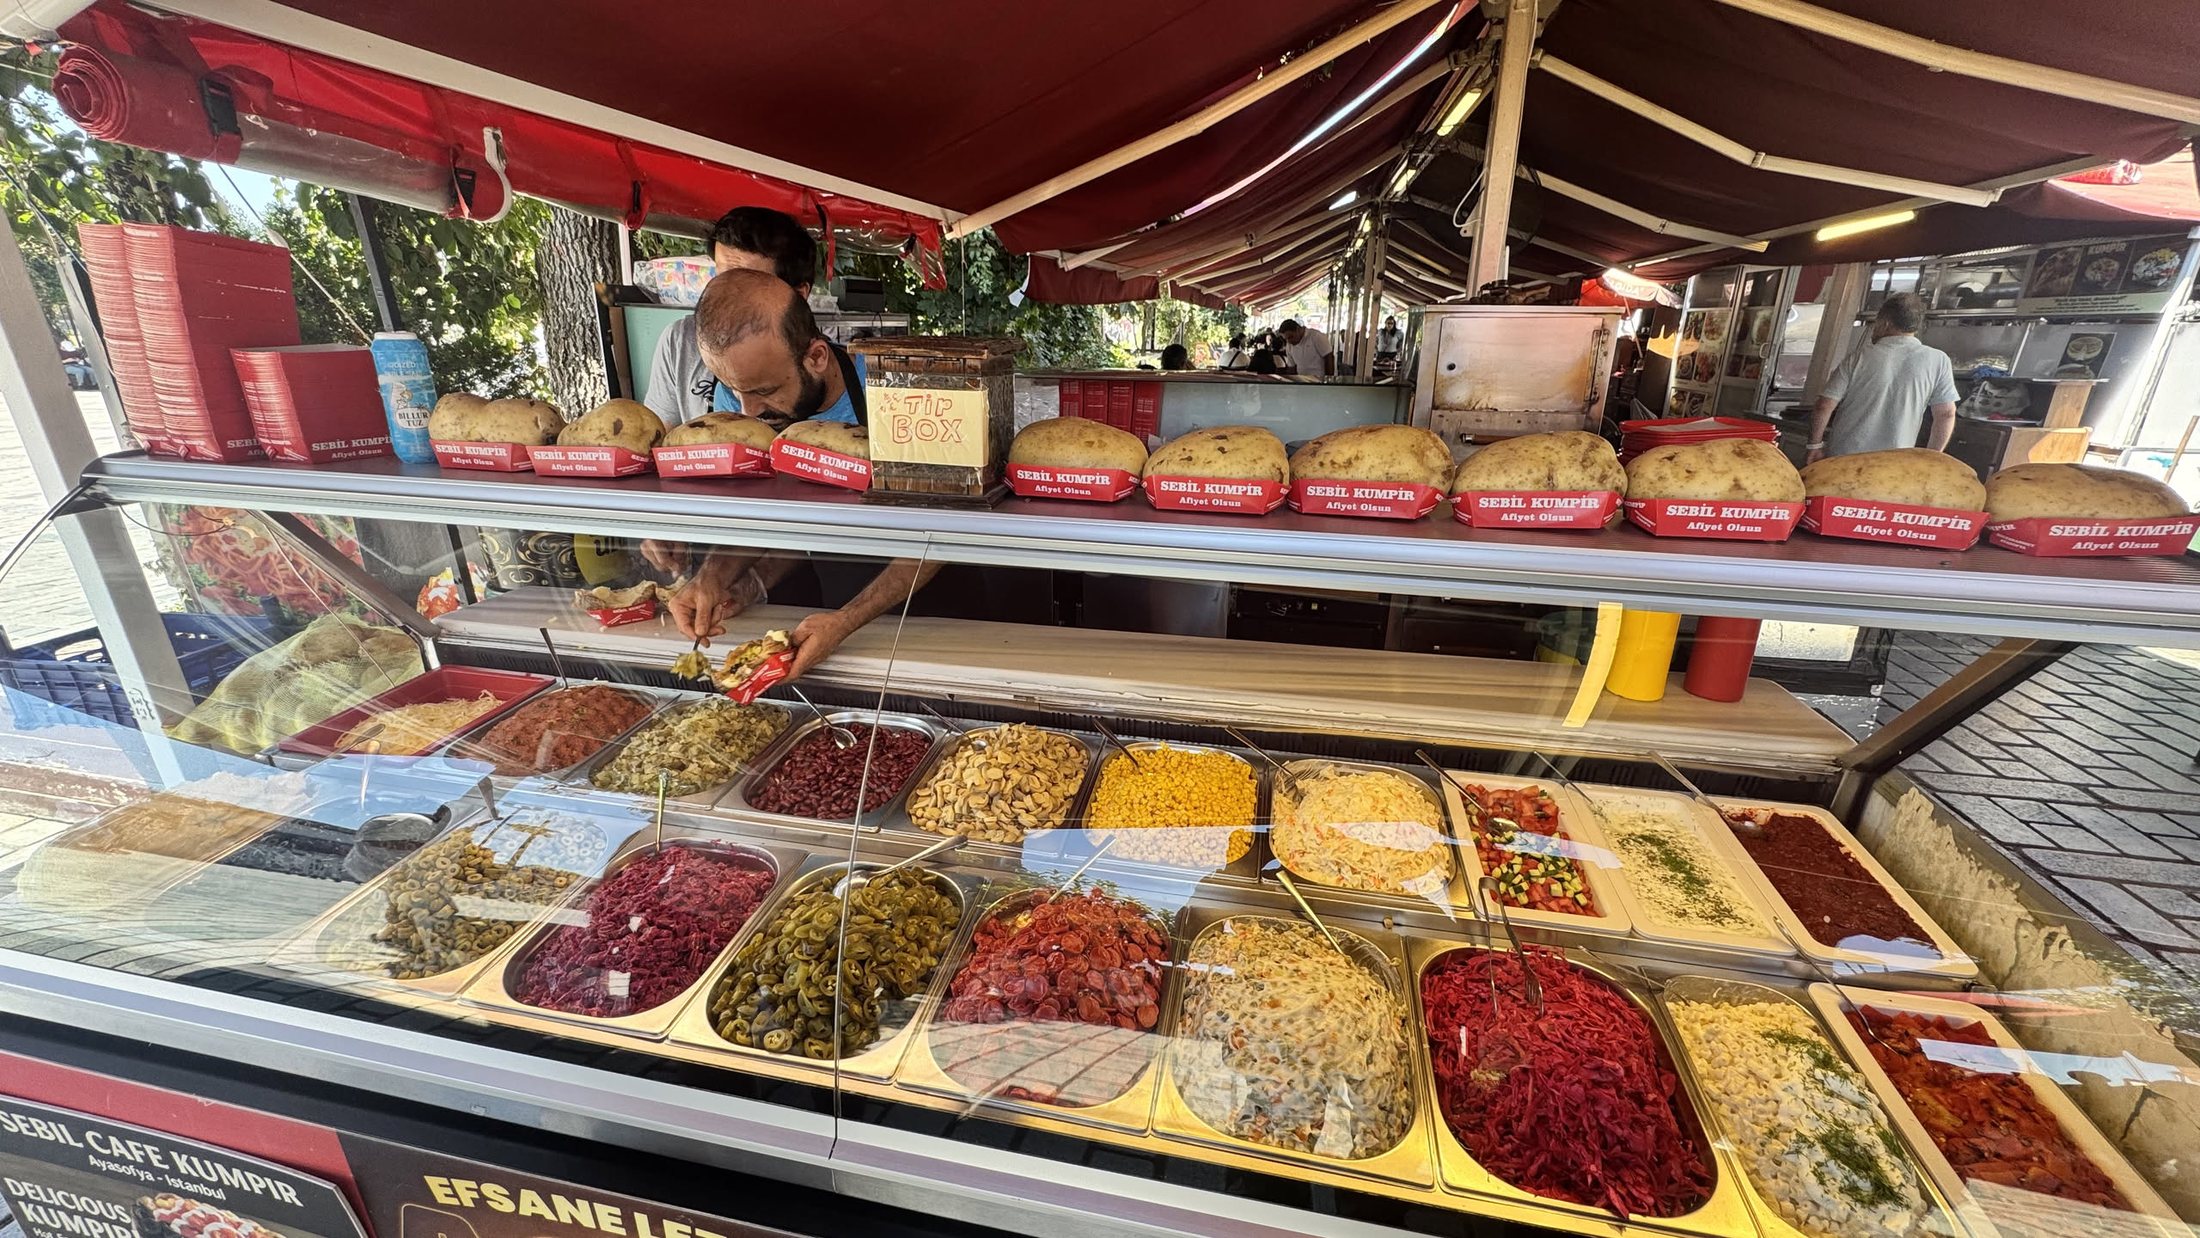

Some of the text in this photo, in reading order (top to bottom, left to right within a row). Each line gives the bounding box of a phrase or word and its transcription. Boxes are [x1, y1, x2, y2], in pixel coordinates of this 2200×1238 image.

[406, 419, 424, 428] TUZ
[892, 414, 962, 444] BOX
[312, 436, 391, 451] SEBİL KUMPİ
[359, 448, 382, 456] Olsun
[435, 443, 507, 457] SEBİL KUMPİR
[534, 449, 611, 461] SEBİL KUMPİR
[780, 443, 867, 475] SEBİL KUMPİR
[795, 461, 848, 481] Afiyet Olsun
[1017, 468, 1110, 485] SEBİL KUMPİR
[1035, 484, 1091, 495] Afiyet Olsun
[1160, 479, 1262, 496] SEBİL KUMPİR
[1306, 484, 1415, 501] SEBİL KUMPİR
[1179, 496, 1241, 507] Afiyet Olsun
[1326, 501, 1391, 512] Afiyet Olsun
[1479, 494, 1526, 508] SEBİL
[1531, 494, 1600, 509] KUMPİR
[1501, 511, 1574, 523] Afiyet Olsun
[1666, 502, 1790, 521] SEBİL KUMPİR
[1832, 503, 1972, 531] SEBİL KUMPİR
[1686, 521, 1762, 533] Afiyet Olsun
[1853, 524, 1937, 541] Afiyet Olsun
[2049, 520, 2194, 537] SEBİL KUMPİR
[2072, 541, 2159, 551] Afiyet Olsun
[0, 1111, 304, 1207] SEBIL CAFE KUMPIR
[88, 1154, 155, 1184] Ayasofya
[166, 1175, 226, 1201] Istanbul
[3, 1177, 132, 1224] DELICIOUS
[424, 1175, 627, 1235] EFSANE
